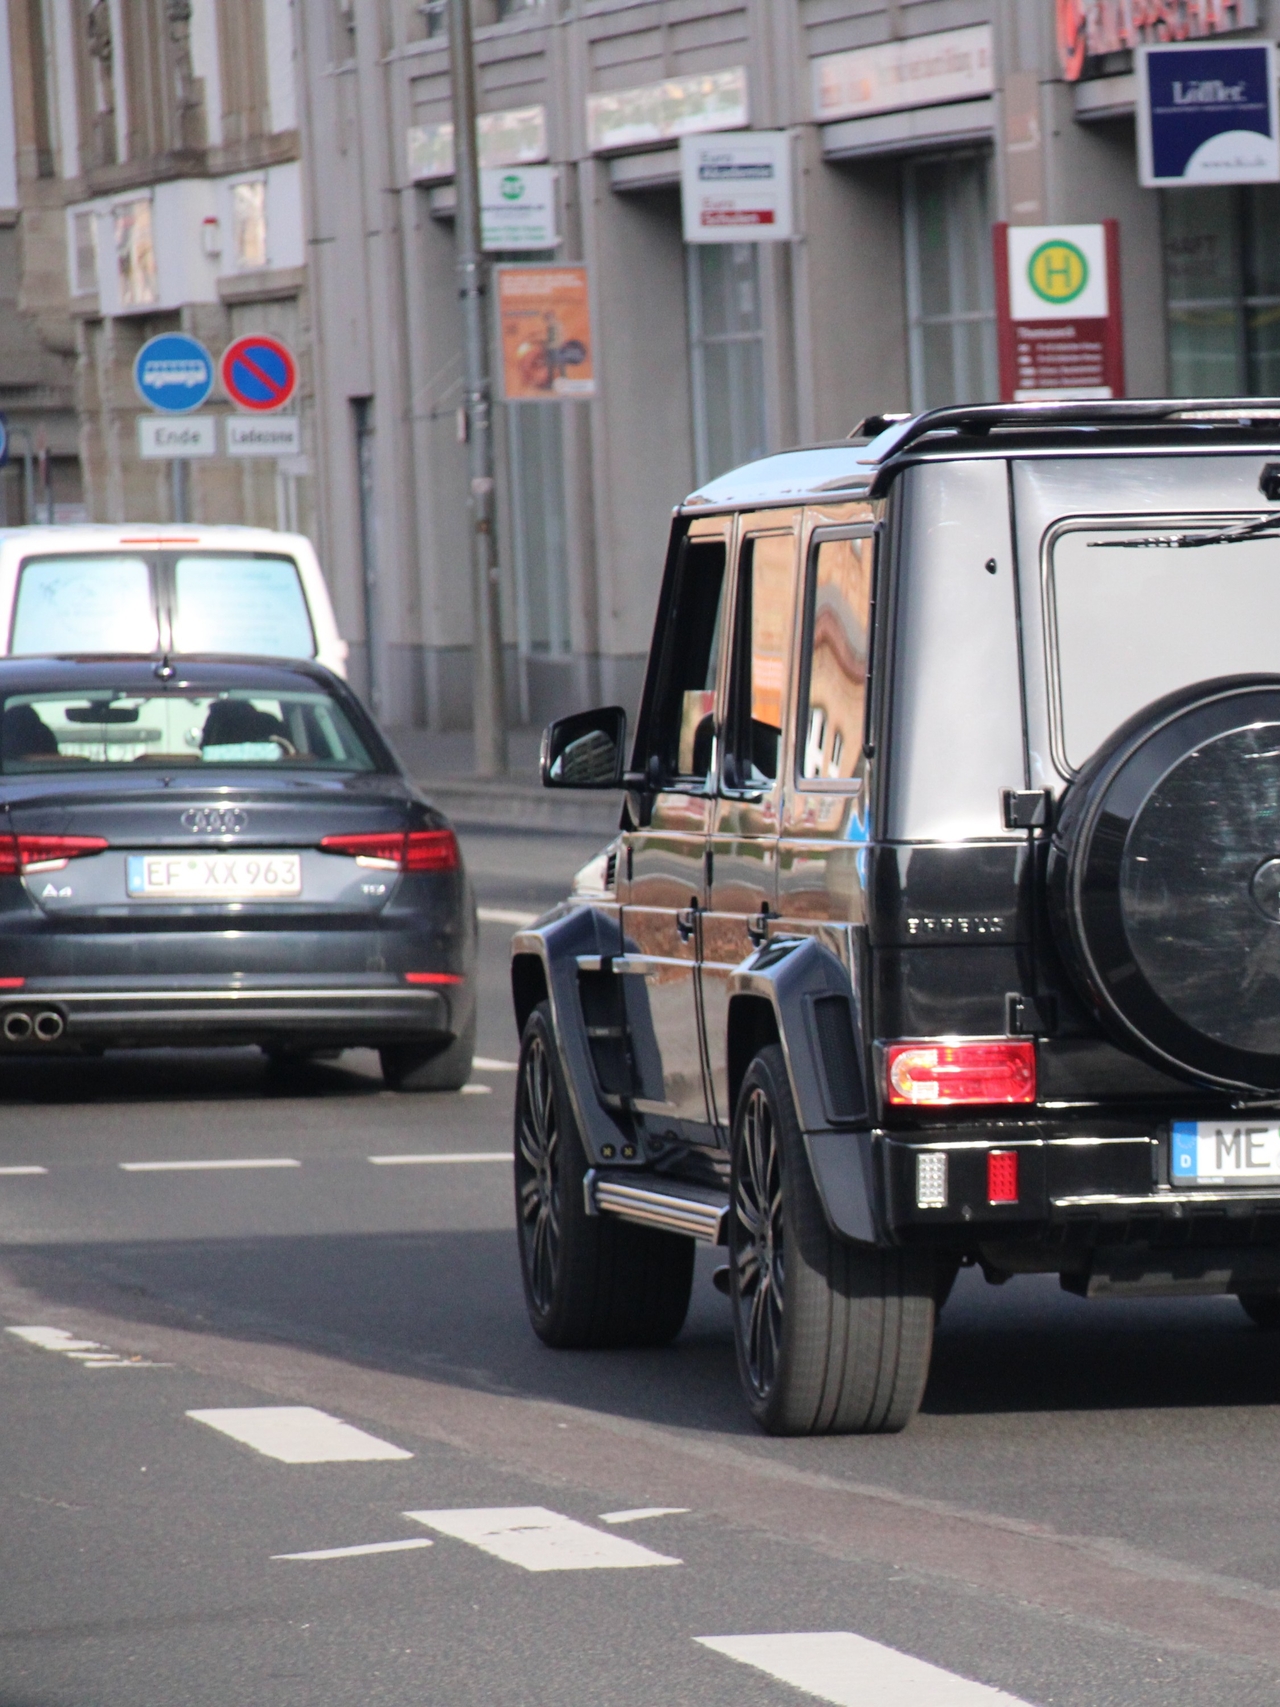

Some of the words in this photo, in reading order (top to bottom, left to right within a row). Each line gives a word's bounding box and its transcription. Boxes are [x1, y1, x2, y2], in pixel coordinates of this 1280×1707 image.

[1045, 254, 1071, 289] H
[154, 427, 200, 446] Ende
[231, 428, 294, 444] Ladezone
[147, 861, 182, 886] EF
[41, 882, 72, 898] A4
[1215, 1127, 1271, 1169] ME
[1180, 1154, 1192, 1169] D
